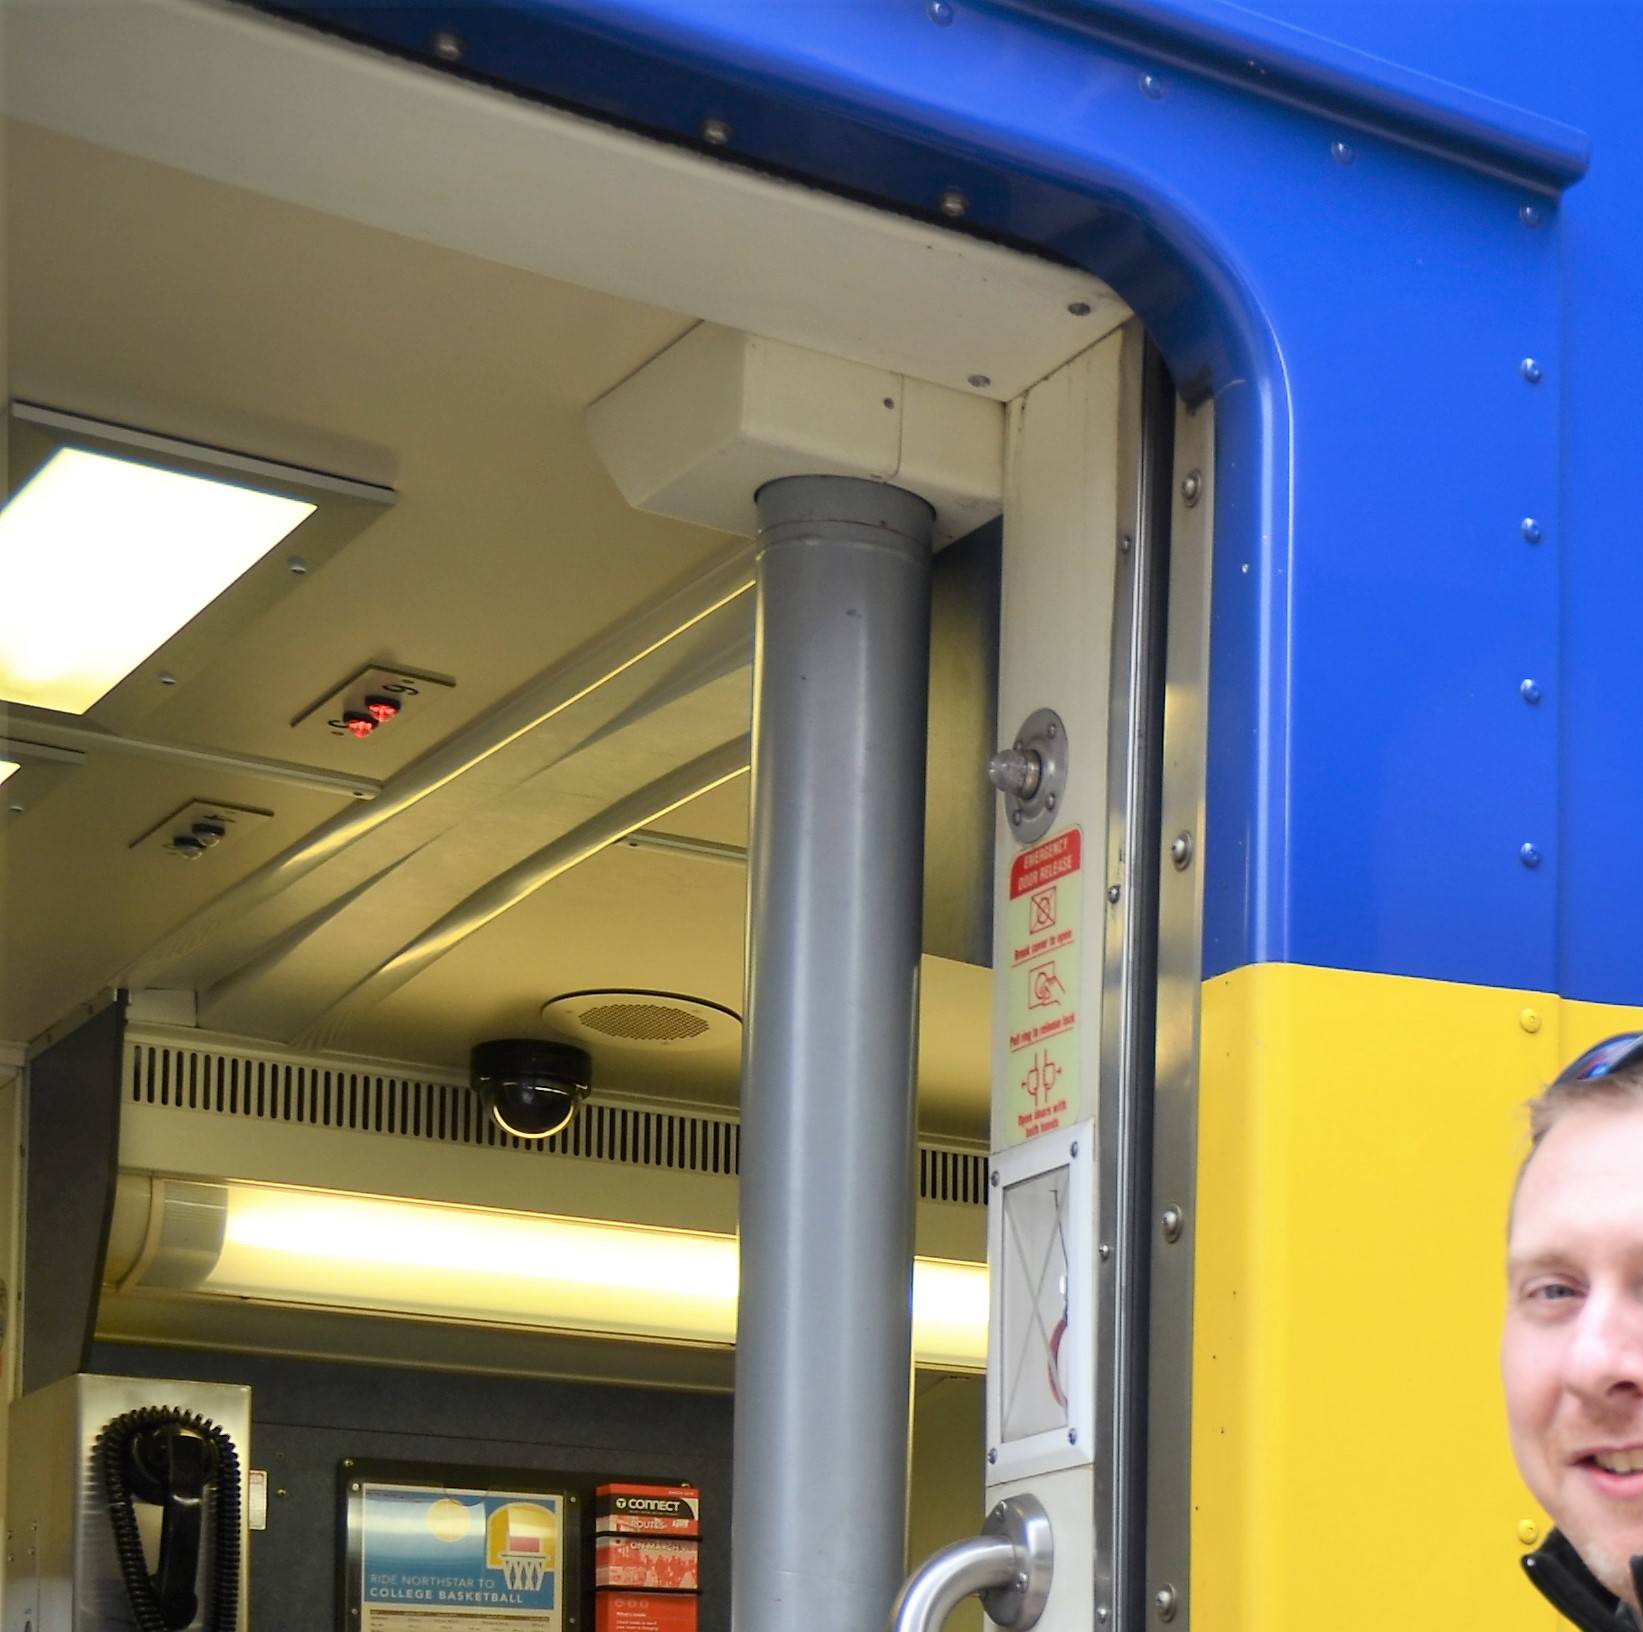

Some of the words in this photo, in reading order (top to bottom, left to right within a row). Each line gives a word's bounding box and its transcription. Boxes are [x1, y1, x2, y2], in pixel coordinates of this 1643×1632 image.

[1023, 837, 1067, 869] EMERGENCY
[1018, 870, 1038, 890] DOOR
[1040, 855, 1073, 881] RELEASE
[370, 1574, 398, 1585] RIDE
[402, 1575, 475, 1587] NORTHSTAR
[478, 1579, 495, 1589] TO
[370, 1587, 433, 1600] COLLEGE
[439, 1589, 524, 1604] BASKETBALL
